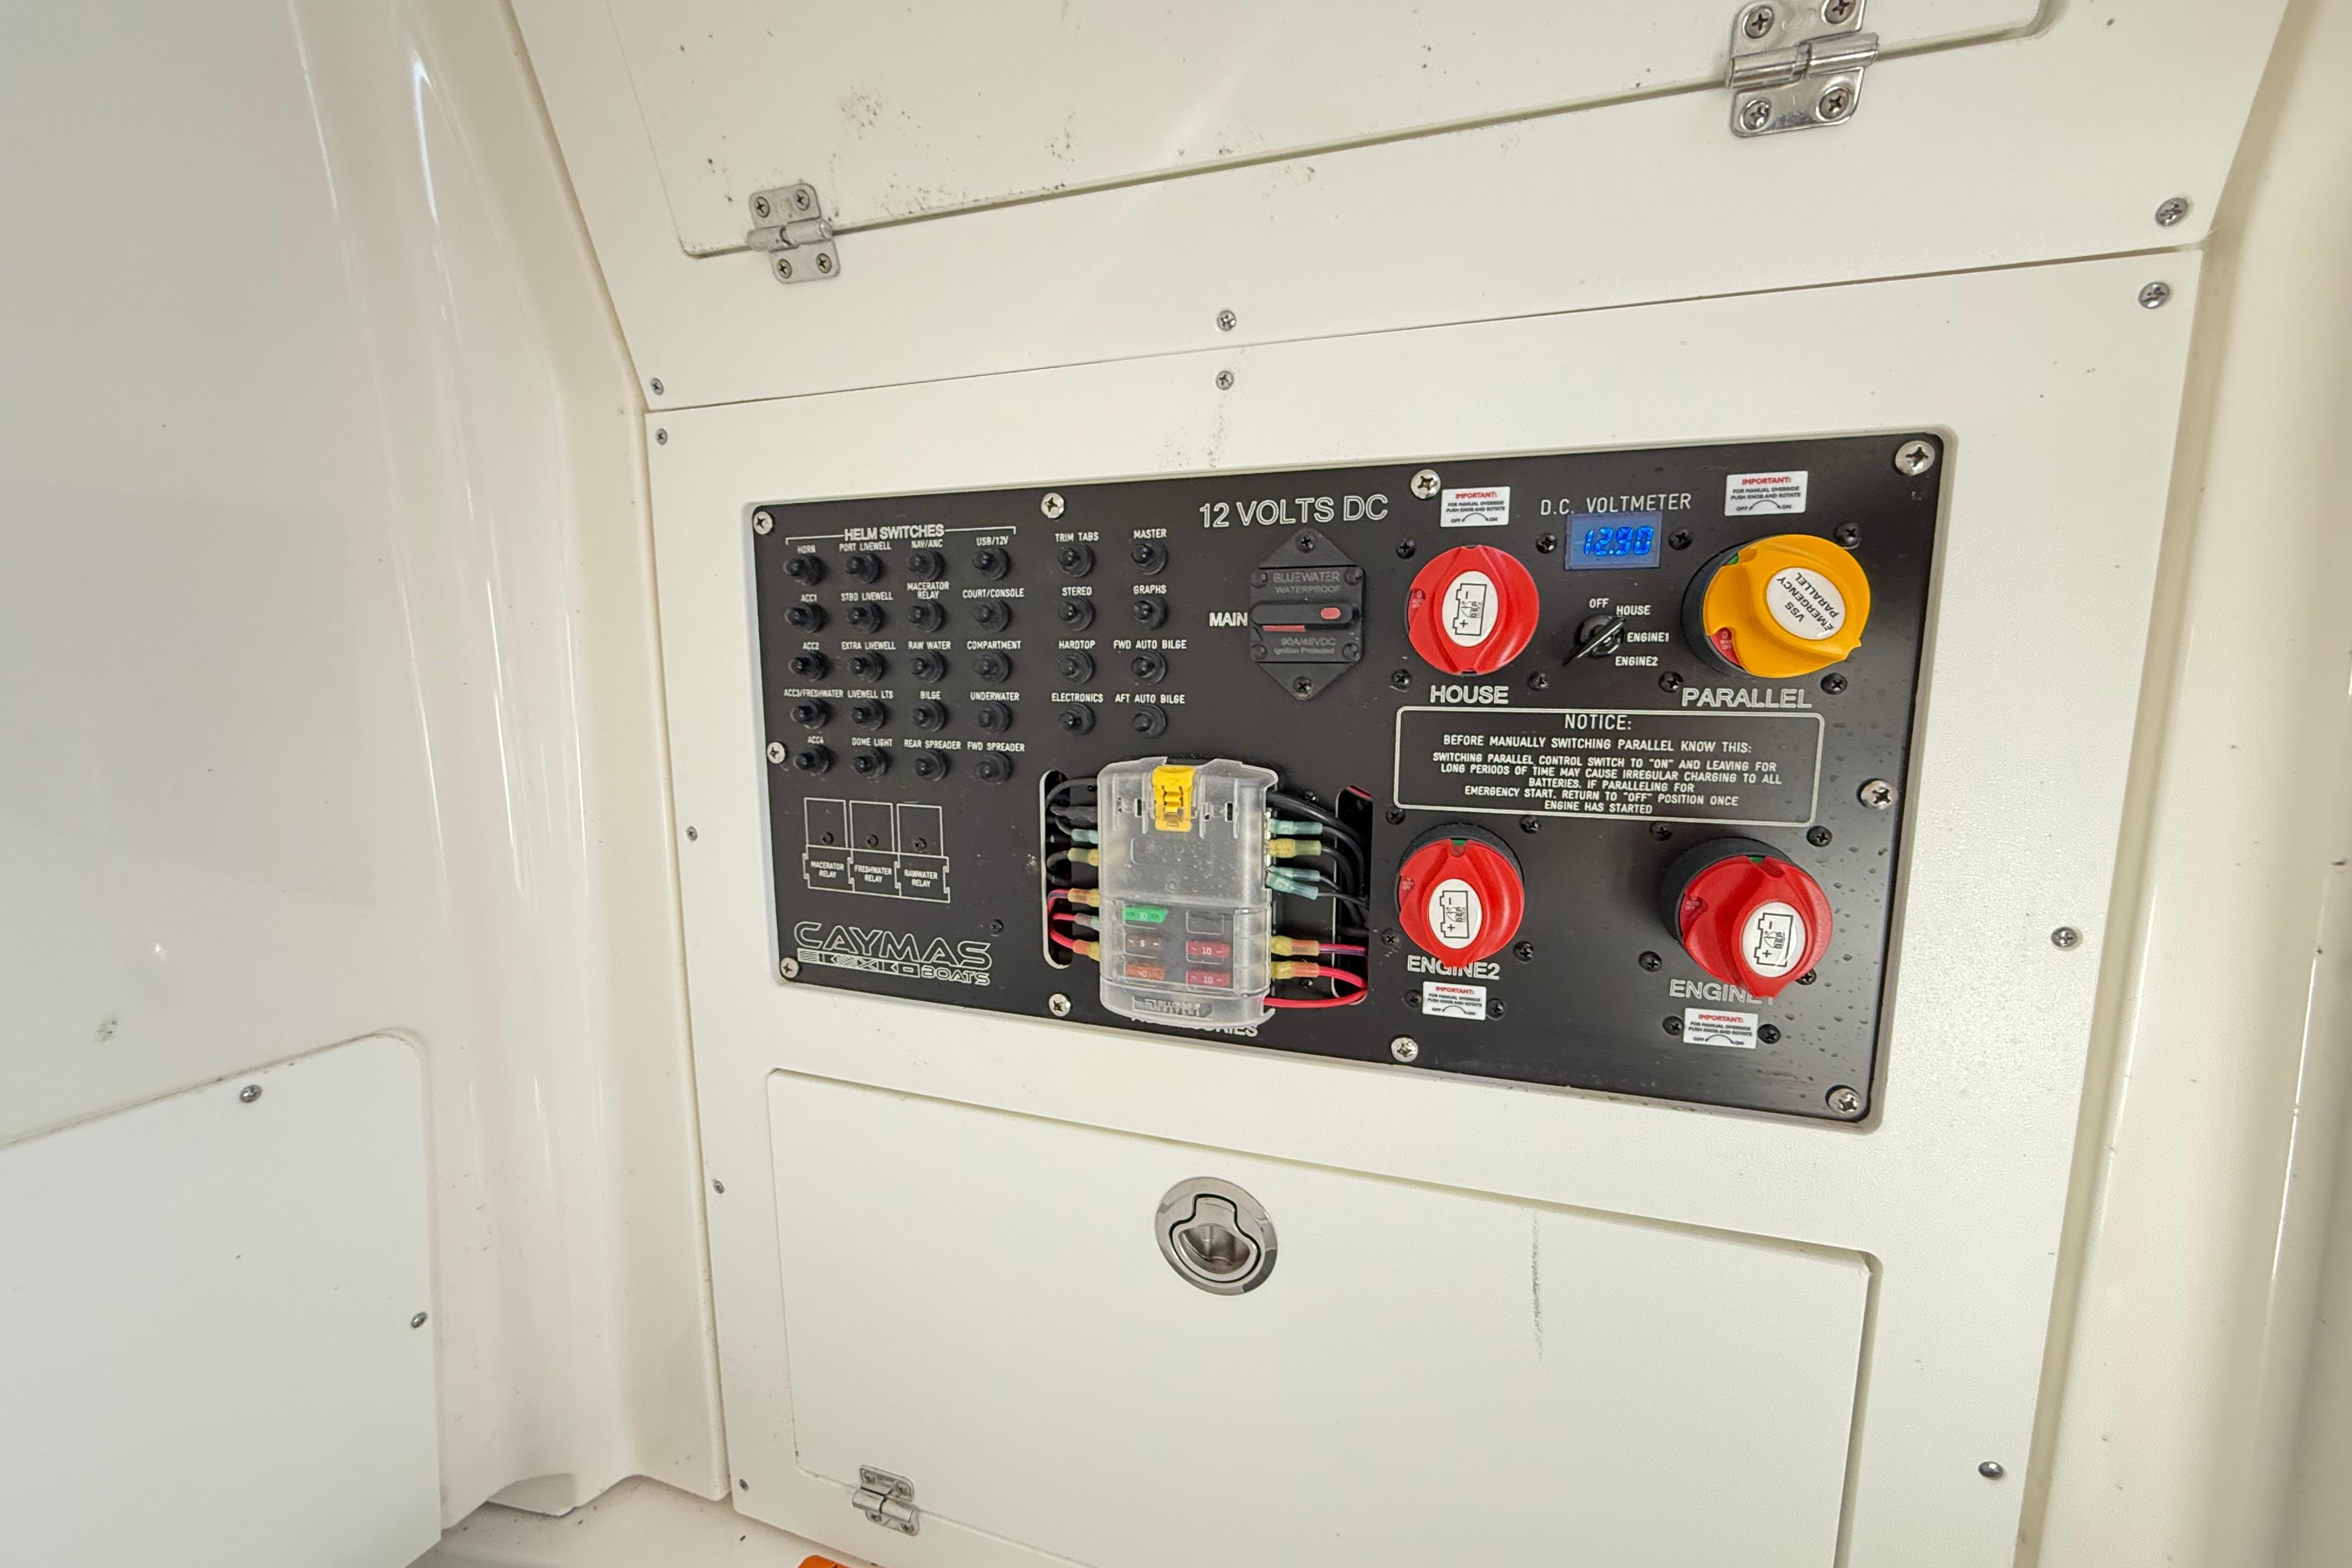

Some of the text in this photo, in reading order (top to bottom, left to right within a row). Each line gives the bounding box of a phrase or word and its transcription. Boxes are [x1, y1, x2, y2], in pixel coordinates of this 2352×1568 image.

[1742, 477, 1791, 485] IMPORTANT:
[1541, 494, 1692, 515] D.C. VOLTMETER
[1199, 494, 1388, 527] 12 VOLTS DC
[845, 524, 944, 541] HELM SWITCHES
[1055, 532, 1099, 542] TRIM TABS
[1133, 528, 1167, 539] MASTER
[911, 539, 943, 548] NAV/ANC
[977, 536, 1009, 546] USB/12V
[1583, 526, 1654, 556] 12.90
[797, 545, 816, 554] HORN
[839, 541, 891, 552] PORT LIVEWELL
[1273, 572, 1339, 582] BLUEWATER
[907, 582, 949, 591] MACERATOR
[1062, 587, 1092, 596] STEREO
[1133, 584, 1167, 595] GRAPHS
[1275, 586, 1340, 594] WATERPROOF
[800, 594, 817, 602] ACC1
[841, 592, 894, 601] STBD LIVEWELL
[917, 590, 939, 600] RELAY
[963, 588, 1024, 598] COURT/CONSOLE
[1796, 572, 1839, 618] PARALLEL
[1589, 598, 1609, 609] OFF
[1777, 577, 1834, 631] EMERGENCY
[1616, 606, 1651, 616] HOUSE
[1785, 602, 1804, 622] VSS
[1209, 612, 1248, 626] MAIN
[1627, 632, 1670, 642] ENGINE1
[803, 642, 819, 650] ACC2
[841, 642, 896, 650] EXTRA LIVEWELL
[908, 640, 951, 650] RAW WATER
[967, 640, 1021, 650] COMPARTMENT
[1059, 640, 1096, 649] HARDTOP
[1113, 639, 1186, 649] FWD AUTO BILGE
[1615, 657, 1658, 666] ENGINE2
[848, 690, 894, 699] LIVEWELL LTS
[921, 691, 942, 699] BILGE
[971, 692, 1020, 701] UNDERWATER
[1051, 693, 1104, 703] ELECTRONICS
[1115, 694, 1185, 704] AFT AUTO BILGE
[1430, 685, 1508, 704] HOUSE
[1682, 688, 1812, 708] PARALLEL
[1564, 714, 1632, 730] NOTICE:
[807, 736, 824, 744] ACC4
[852, 737, 892, 747] DOME LIGHT
[904, 739, 961, 750] REAR SPREADER
[1444, 735, 1752, 754] BEFORE MANUALLY SWITCHING PARALLEL KNOW THIS:
[967, 741, 1025, 752] FWD SPREADER
[1433, 752, 1777, 772] SWITCHING PARALLEL CONTROL SWITCH TO "ON" AND LEAVING FOR
[1441, 763, 1782, 785] LONG PERIODS OF TIME MAY CAUSE IRREGULAR CHARGING TO ALL
[1529, 778, 1695, 793] BATTERIES. IF PARALLELING FOR
[1465, 786, 1740, 806] EMERGENCY START. RETURN TO "OFF" POSITION ONCE
[1545, 800, 1653, 814] ENGINE HAS STARTED
[811, 861, 845, 870] MACERATOR
[854, 864, 892, 875] FRESHWATER
[864, 874, 882, 883] RELAY
[912, 878, 930, 888] RELAY
[794, 921, 992, 971] CAYMAS
[1140, 939, 1146, 947] 5
[1202, 947, 1212, 955] 10
[922, 965, 991, 986] BOATS
[1203, 976, 1213, 985] 10
[1699, 1014, 1743, 1023] IMPORTANT:
